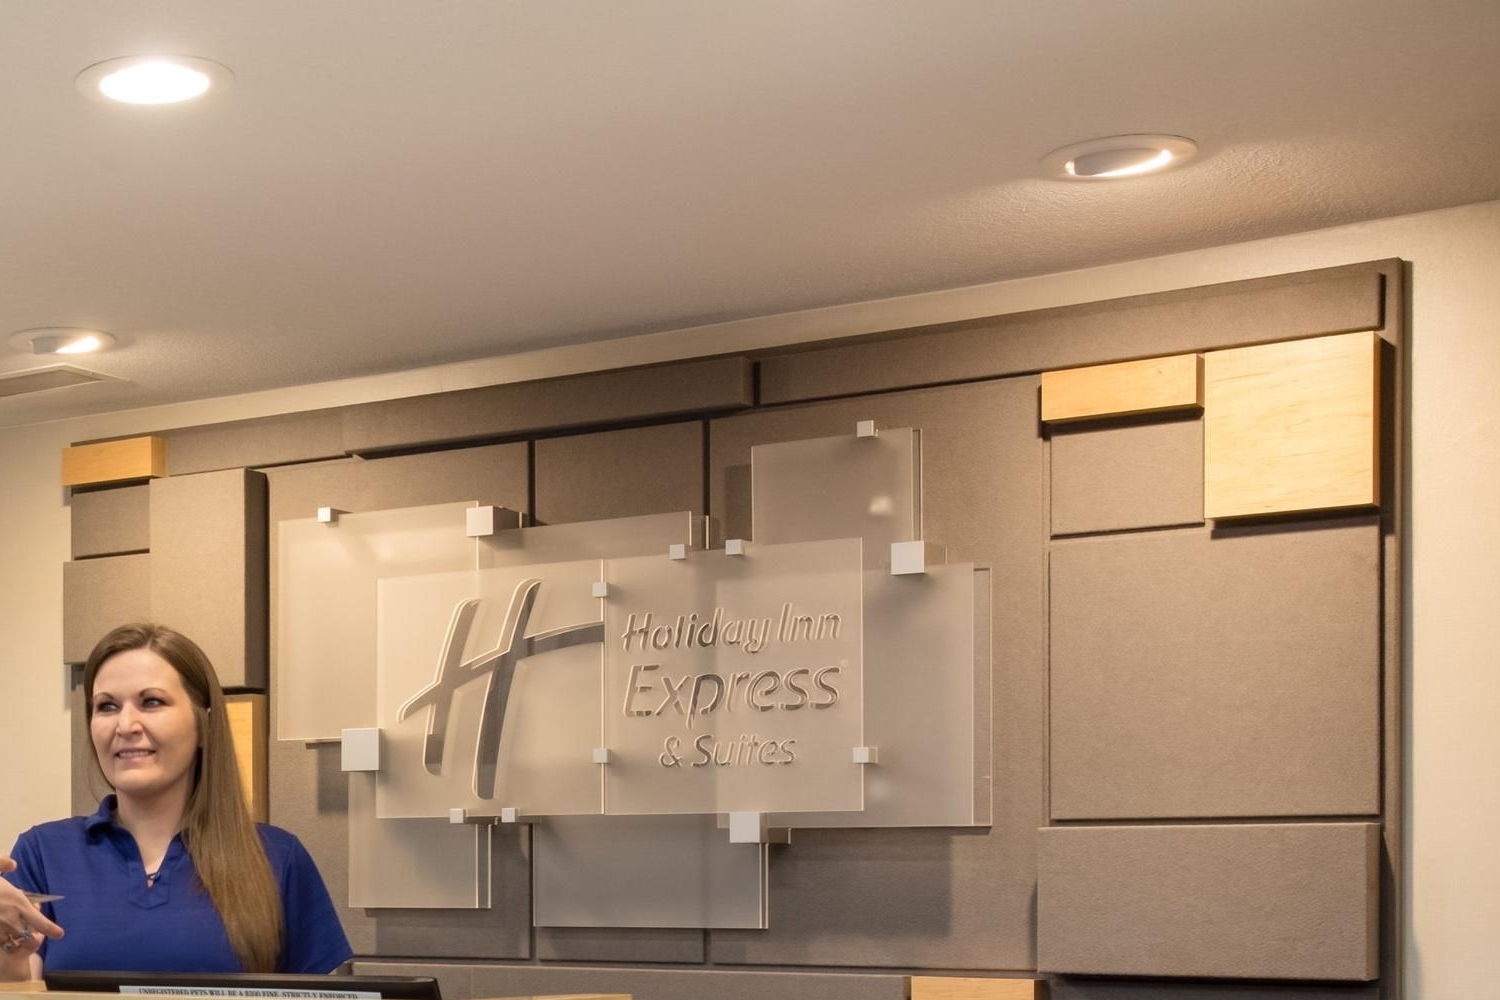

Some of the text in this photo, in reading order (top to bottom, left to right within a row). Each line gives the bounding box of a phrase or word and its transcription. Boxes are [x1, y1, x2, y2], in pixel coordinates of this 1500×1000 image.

[622, 602, 842, 654] Holiday Inn
[623, 663, 842, 729] Express
[658, 733, 796, 768] & Suites
